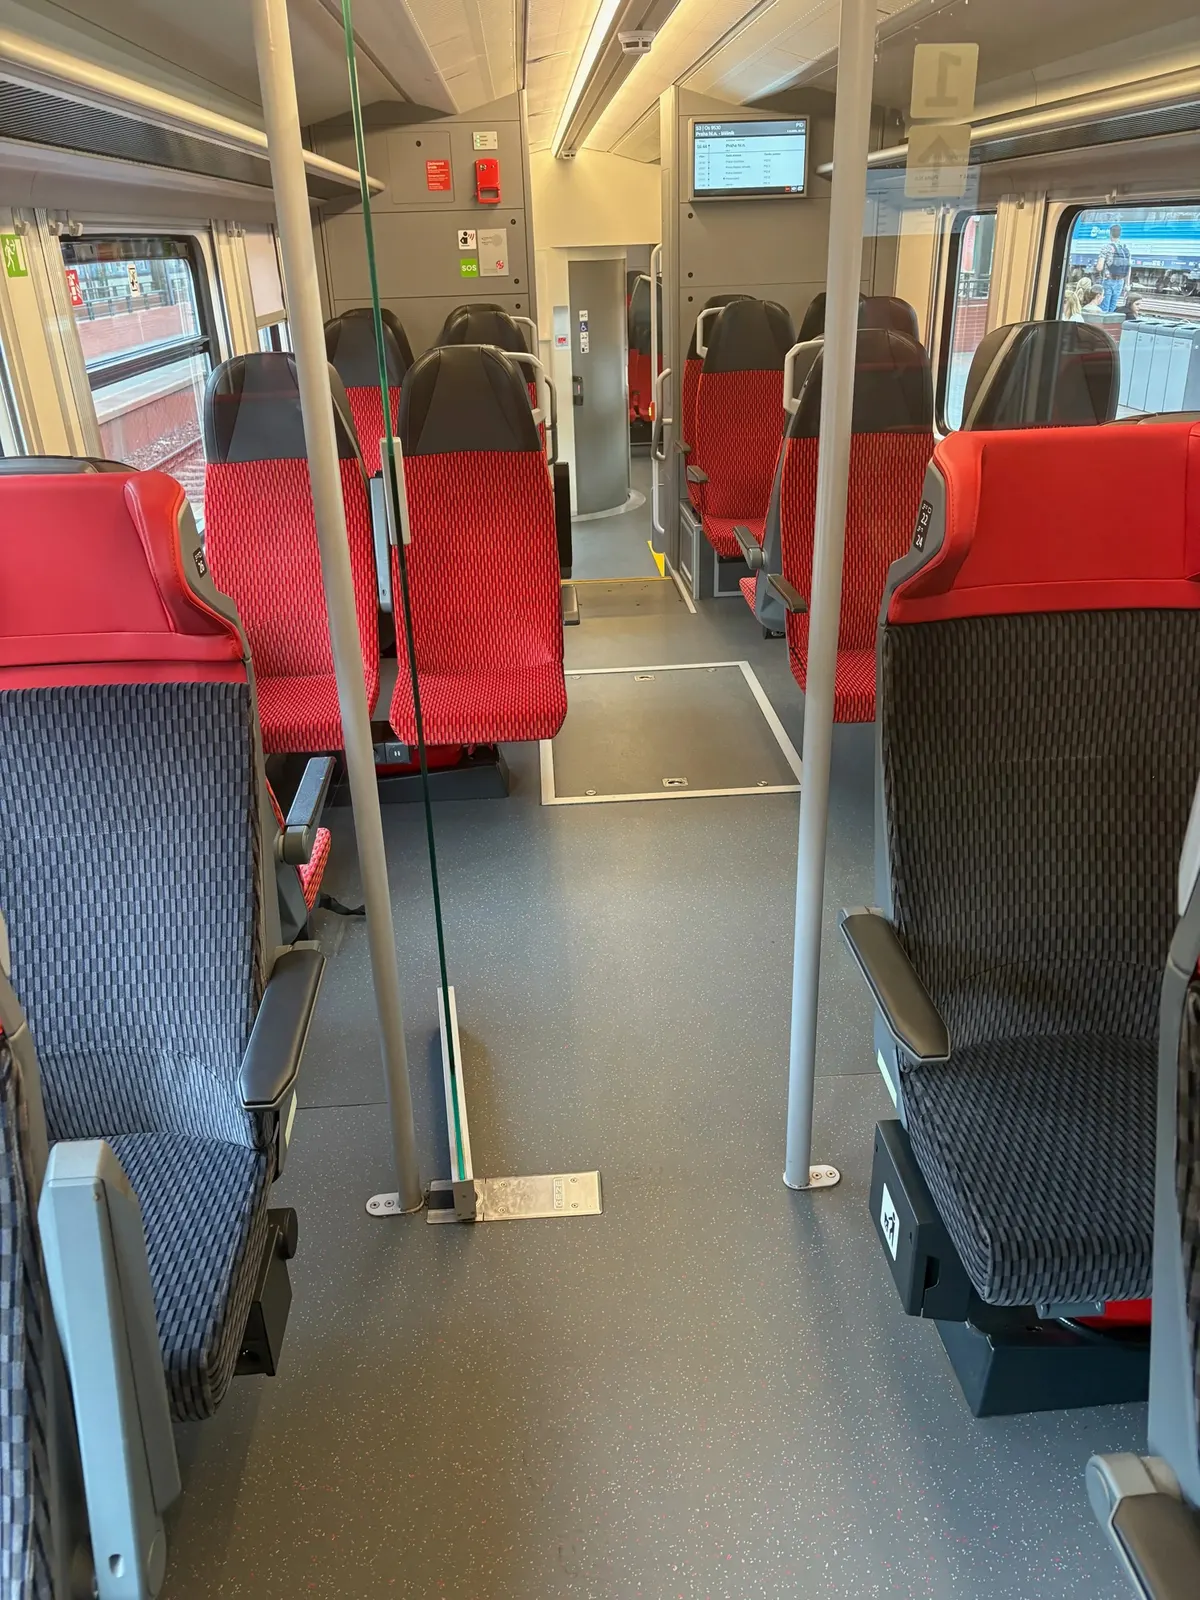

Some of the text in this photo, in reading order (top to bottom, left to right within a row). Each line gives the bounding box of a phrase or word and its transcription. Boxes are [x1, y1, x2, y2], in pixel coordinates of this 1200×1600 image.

[461, 264, 477, 272] SOS
[920, 512, 929, 526] 22
[915, 534, 924, 548] 24
